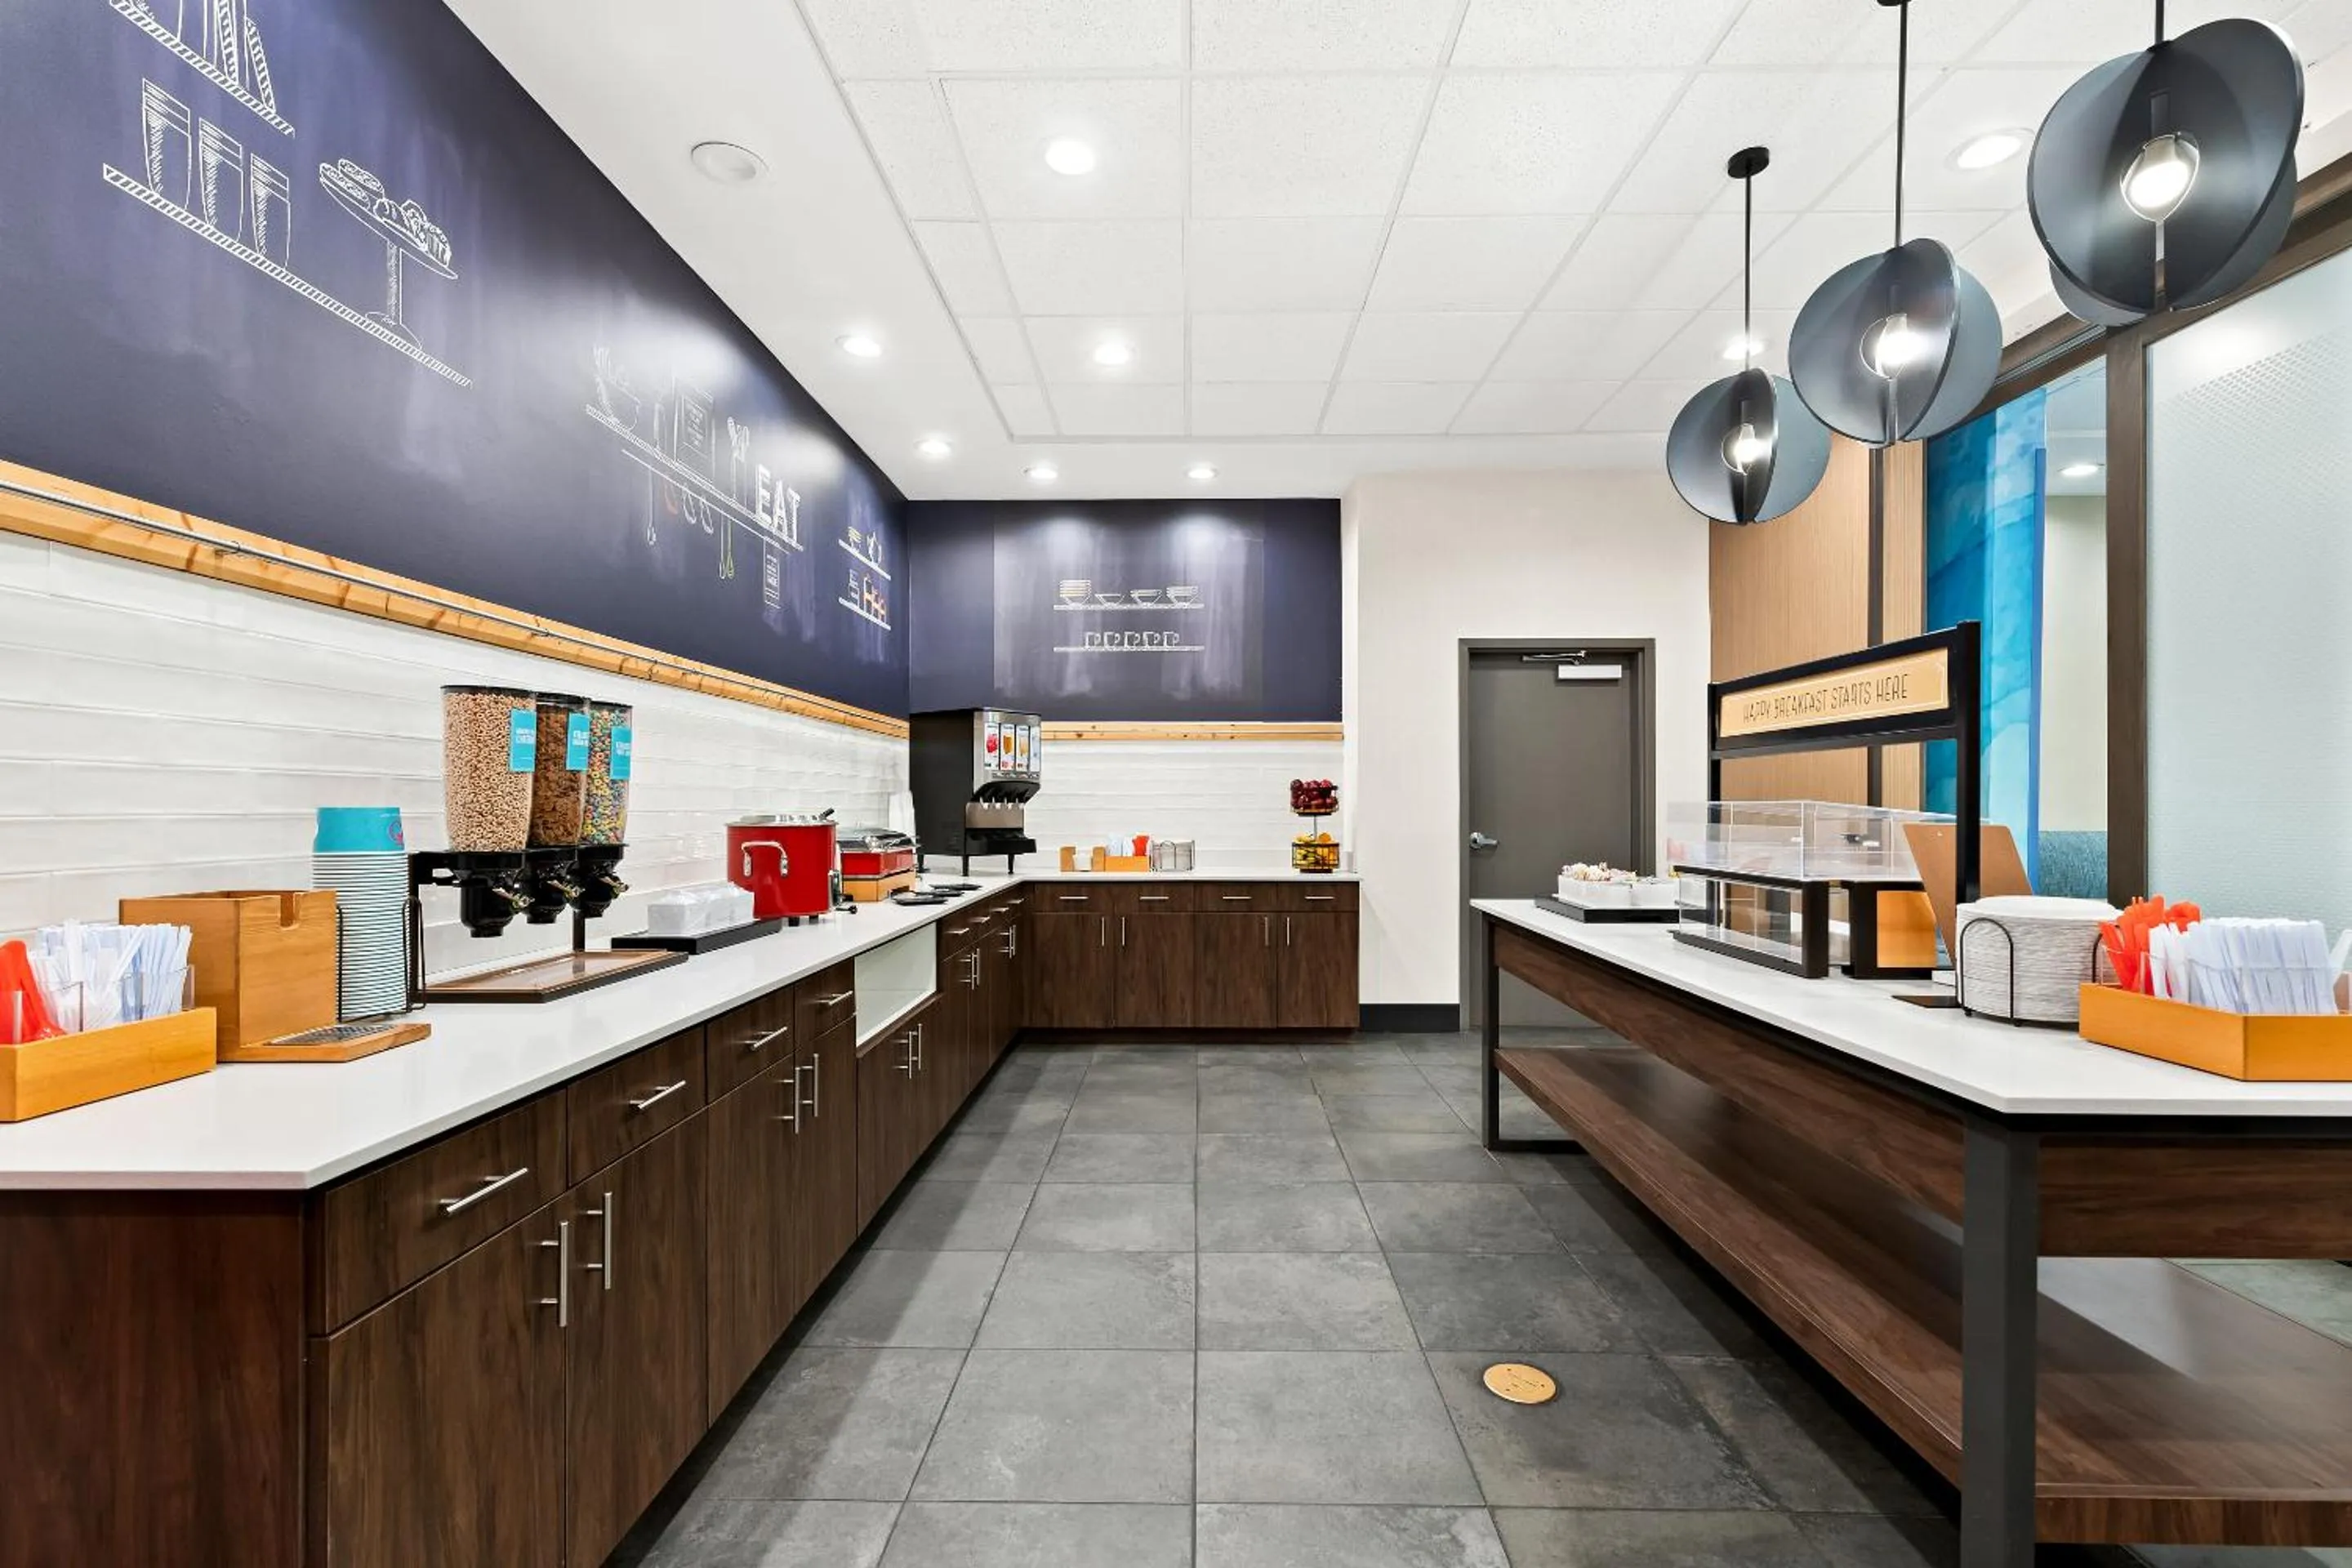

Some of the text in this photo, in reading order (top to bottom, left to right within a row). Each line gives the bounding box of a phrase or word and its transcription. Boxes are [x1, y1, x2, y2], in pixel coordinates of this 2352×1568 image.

[755, 463, 800, 543] EAT
[1743, 673, 1909, 724] HAPPY BREAKFAST STARTS HERE
